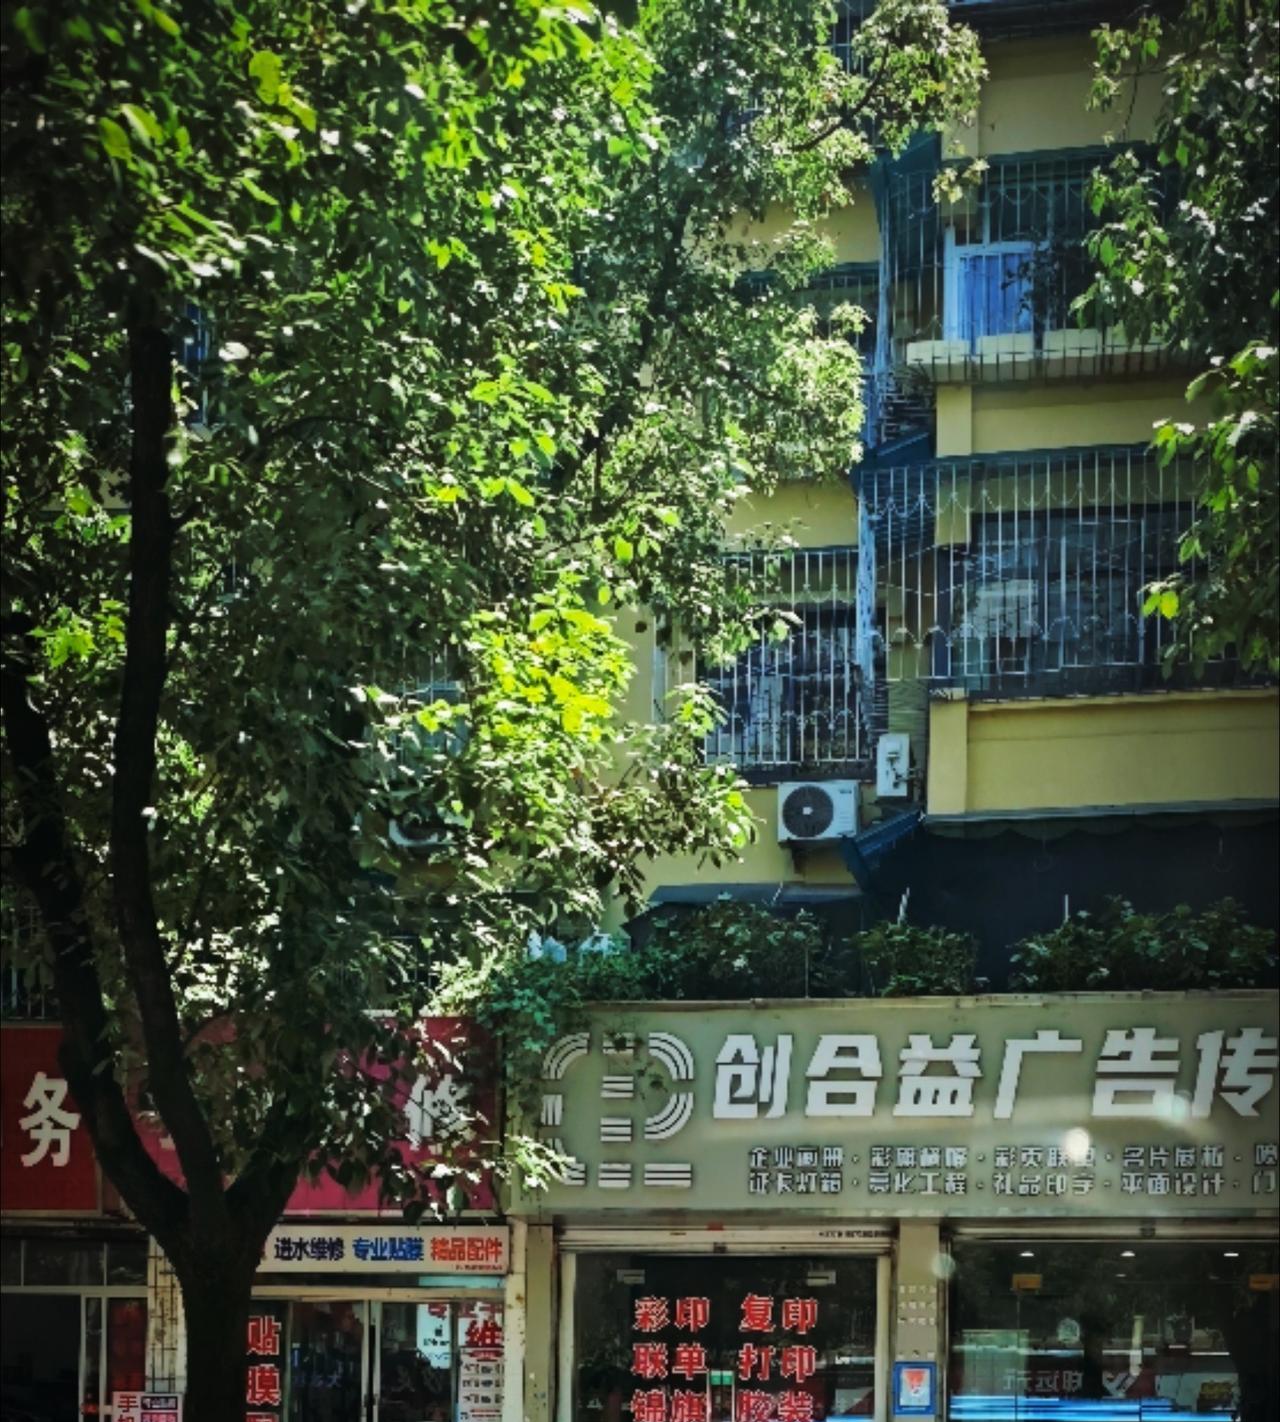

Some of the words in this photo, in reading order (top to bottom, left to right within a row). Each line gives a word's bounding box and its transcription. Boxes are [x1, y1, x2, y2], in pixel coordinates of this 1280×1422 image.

[713, 1027, 1279, 1120] 创合益广告传
[19, 1071, 81, 1168] 务
[1122, 1172, 1224, 1195] 平面设计
[274, 1237, 345, 1261] 进水维修
[352, 1237, 425, 1261] 专业贴膜
[430, 1237, 503, 1262] 精品配件
[633, 1295, 711, 1333] 彩印
[740, 1293, 817, 1334] 复印
[631, 1342, 709, 1381] 联单
[738, 1343, 816, 1383] 打印
